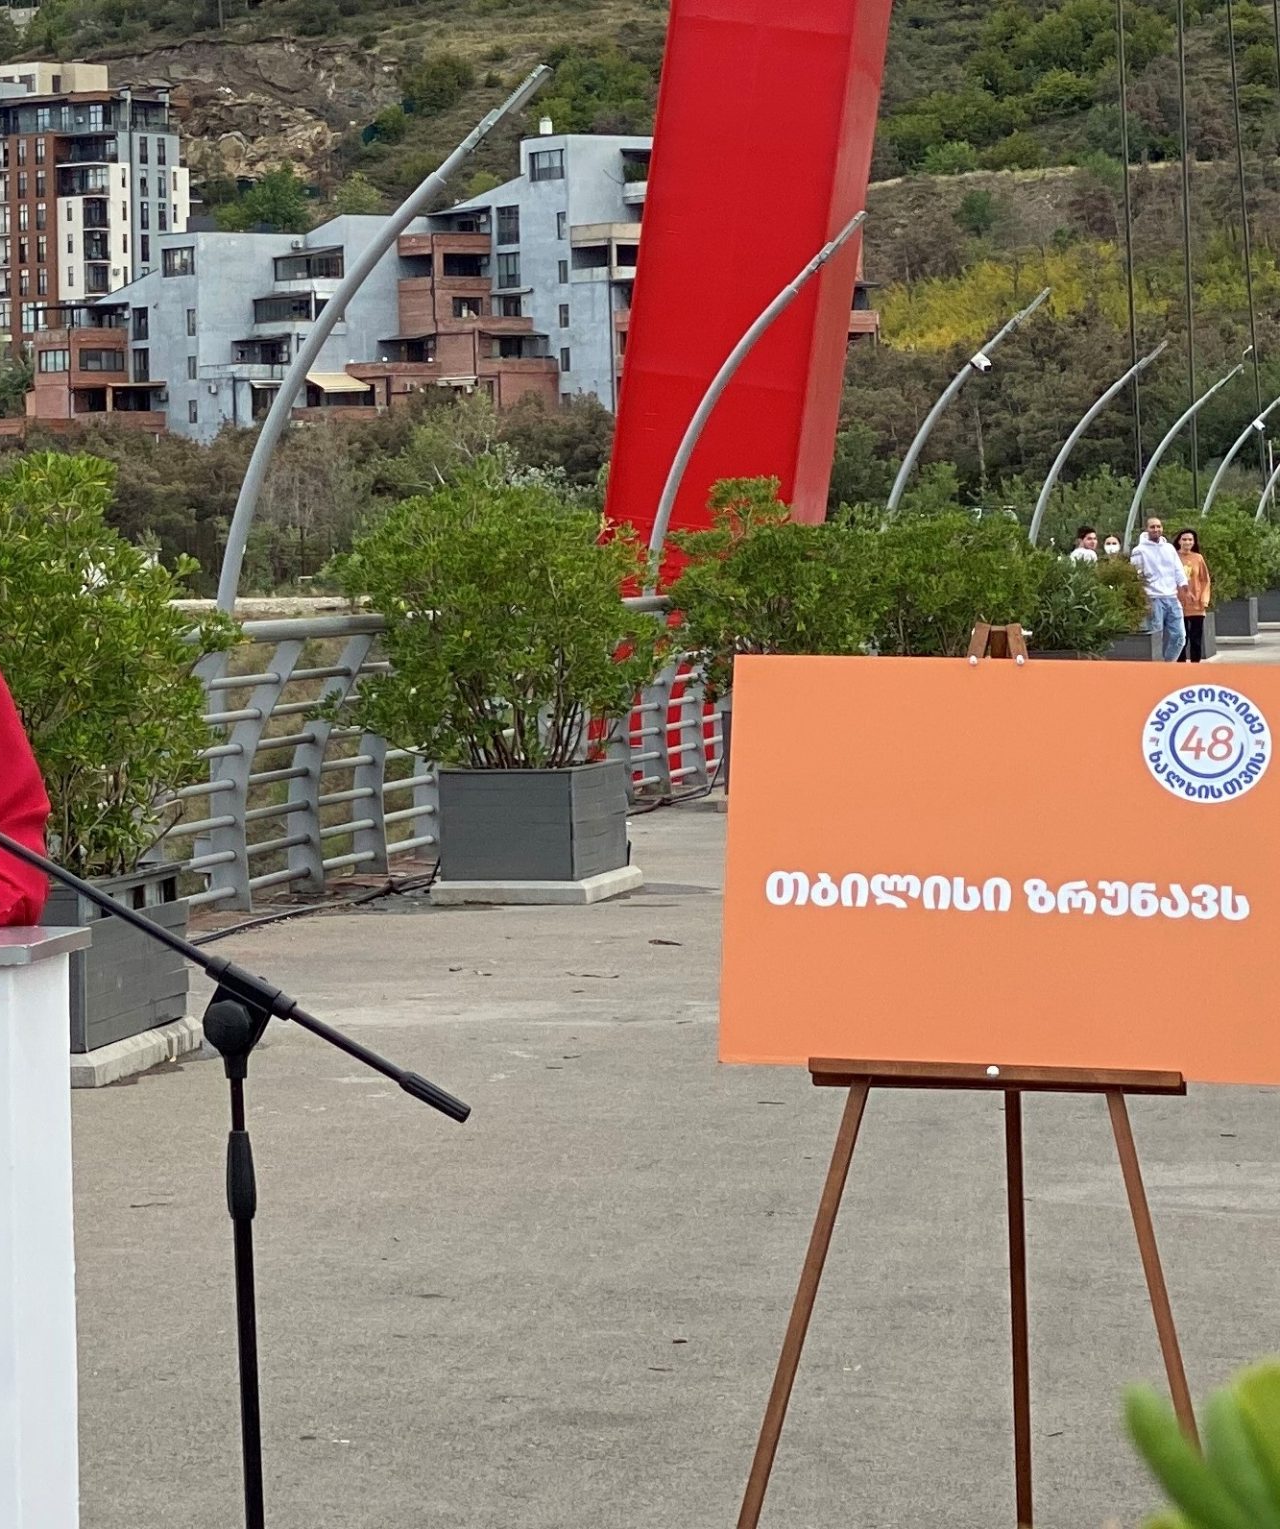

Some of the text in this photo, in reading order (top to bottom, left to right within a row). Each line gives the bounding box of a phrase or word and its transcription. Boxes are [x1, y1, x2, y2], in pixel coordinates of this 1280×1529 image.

[1149, 688, 1265, 734] ანა დოლიძე
[1179, 725, 1234, 761] 48
[1148, 750, 1266, 799] ხალხისთვის
[765, 870, 1250, 921] თბილისი ზრუნავს
